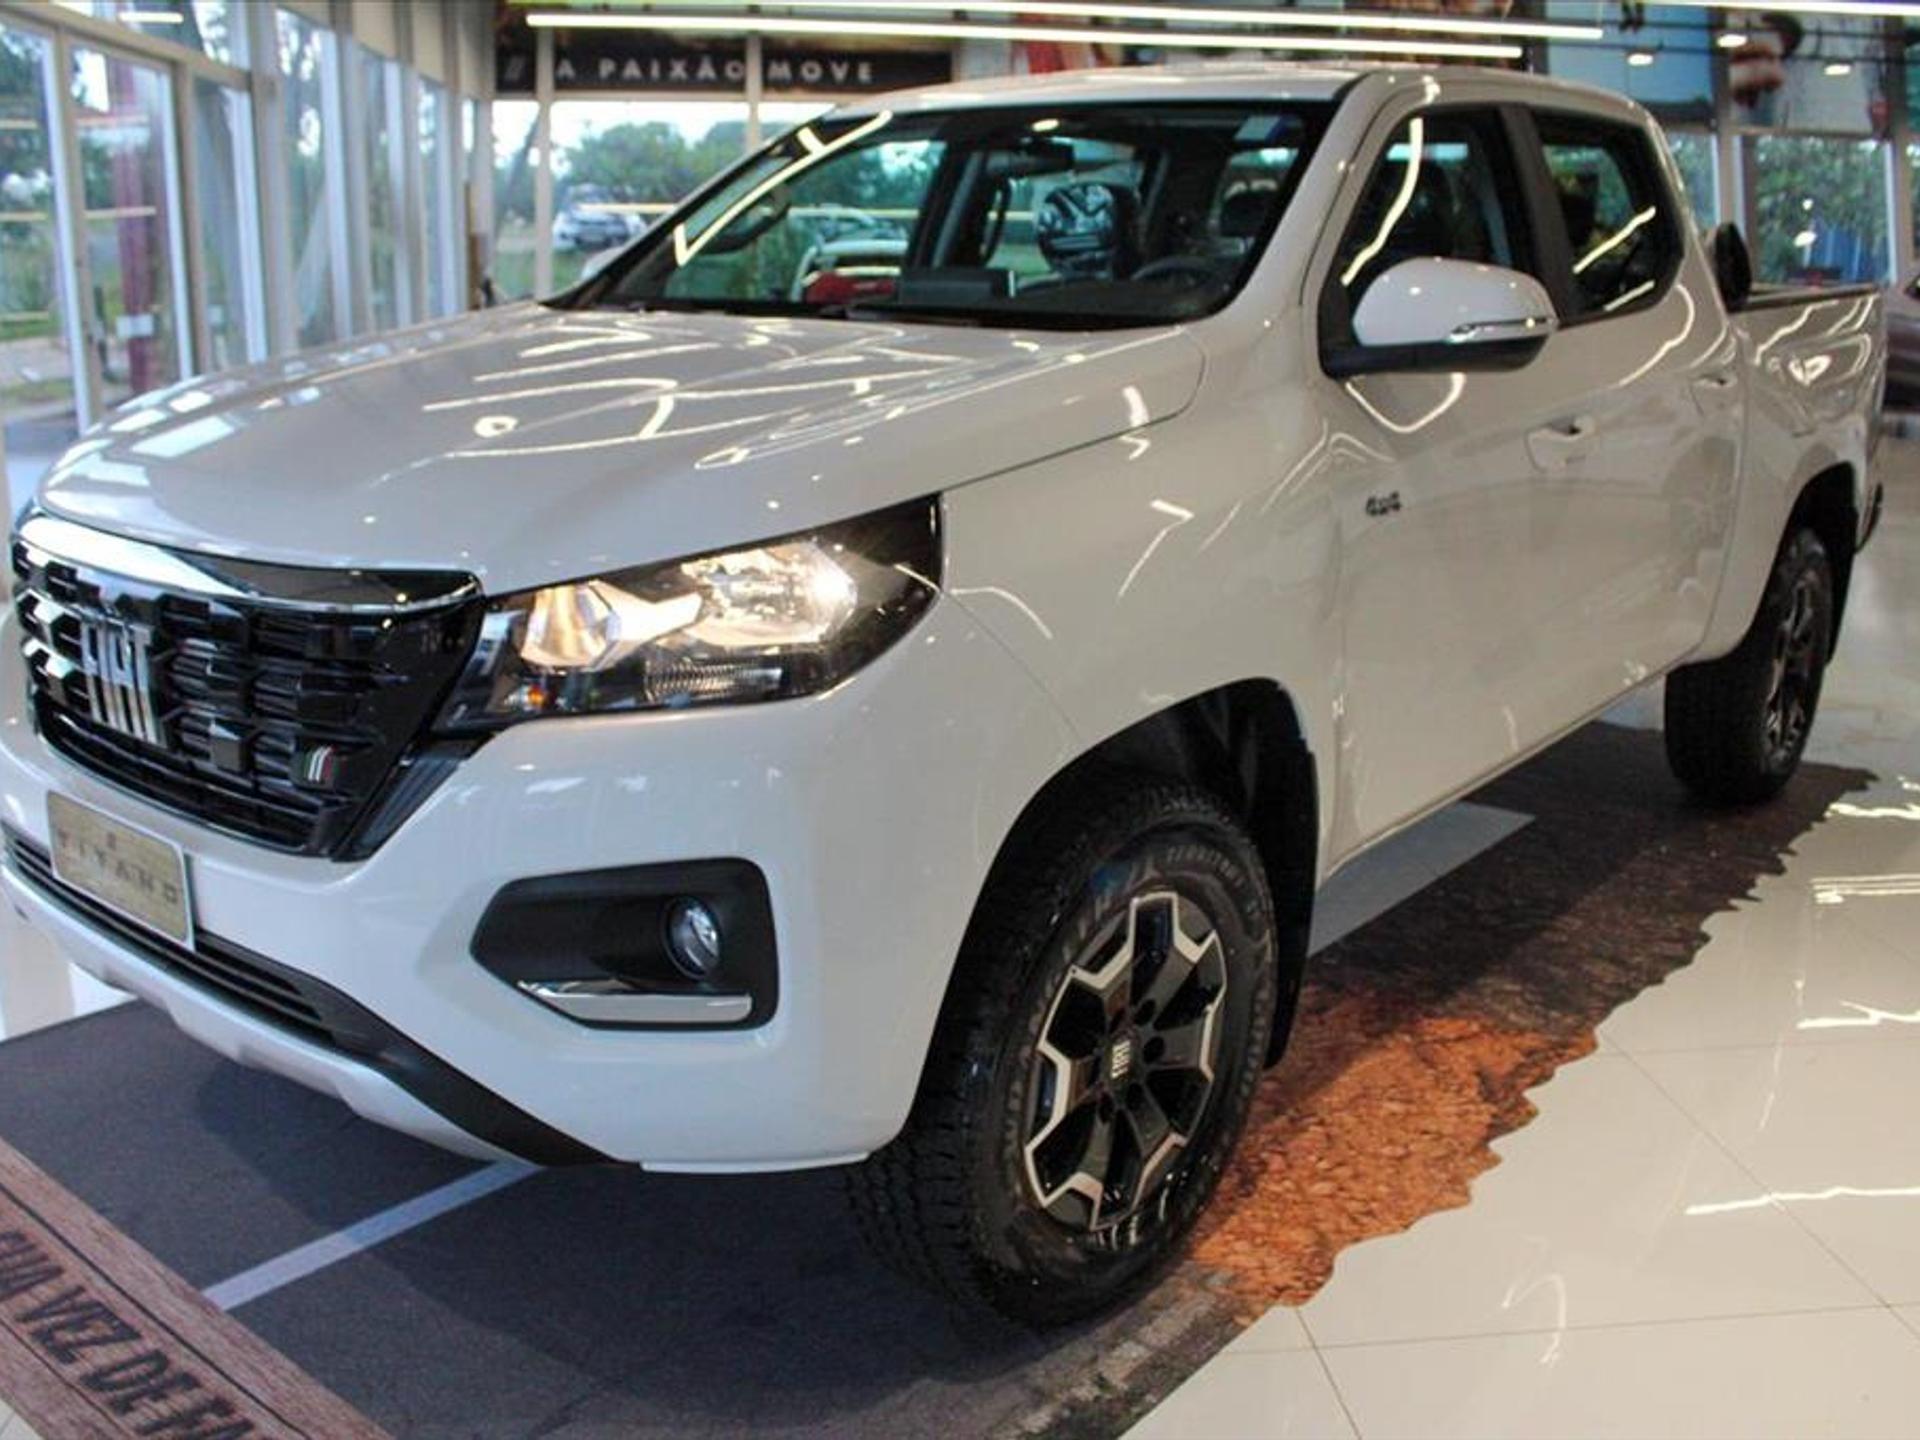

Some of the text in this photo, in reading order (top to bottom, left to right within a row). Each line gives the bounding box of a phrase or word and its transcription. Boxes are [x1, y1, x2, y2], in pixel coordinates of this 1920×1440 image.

[556, 57, 577, 80] A
[600, 54, 744, 81] PAIXÃO
[767, 60, 873, 82] MOVE
[14, 1286, 142, 1364] VEZ
[79, 1348, 200, 1415] DE
